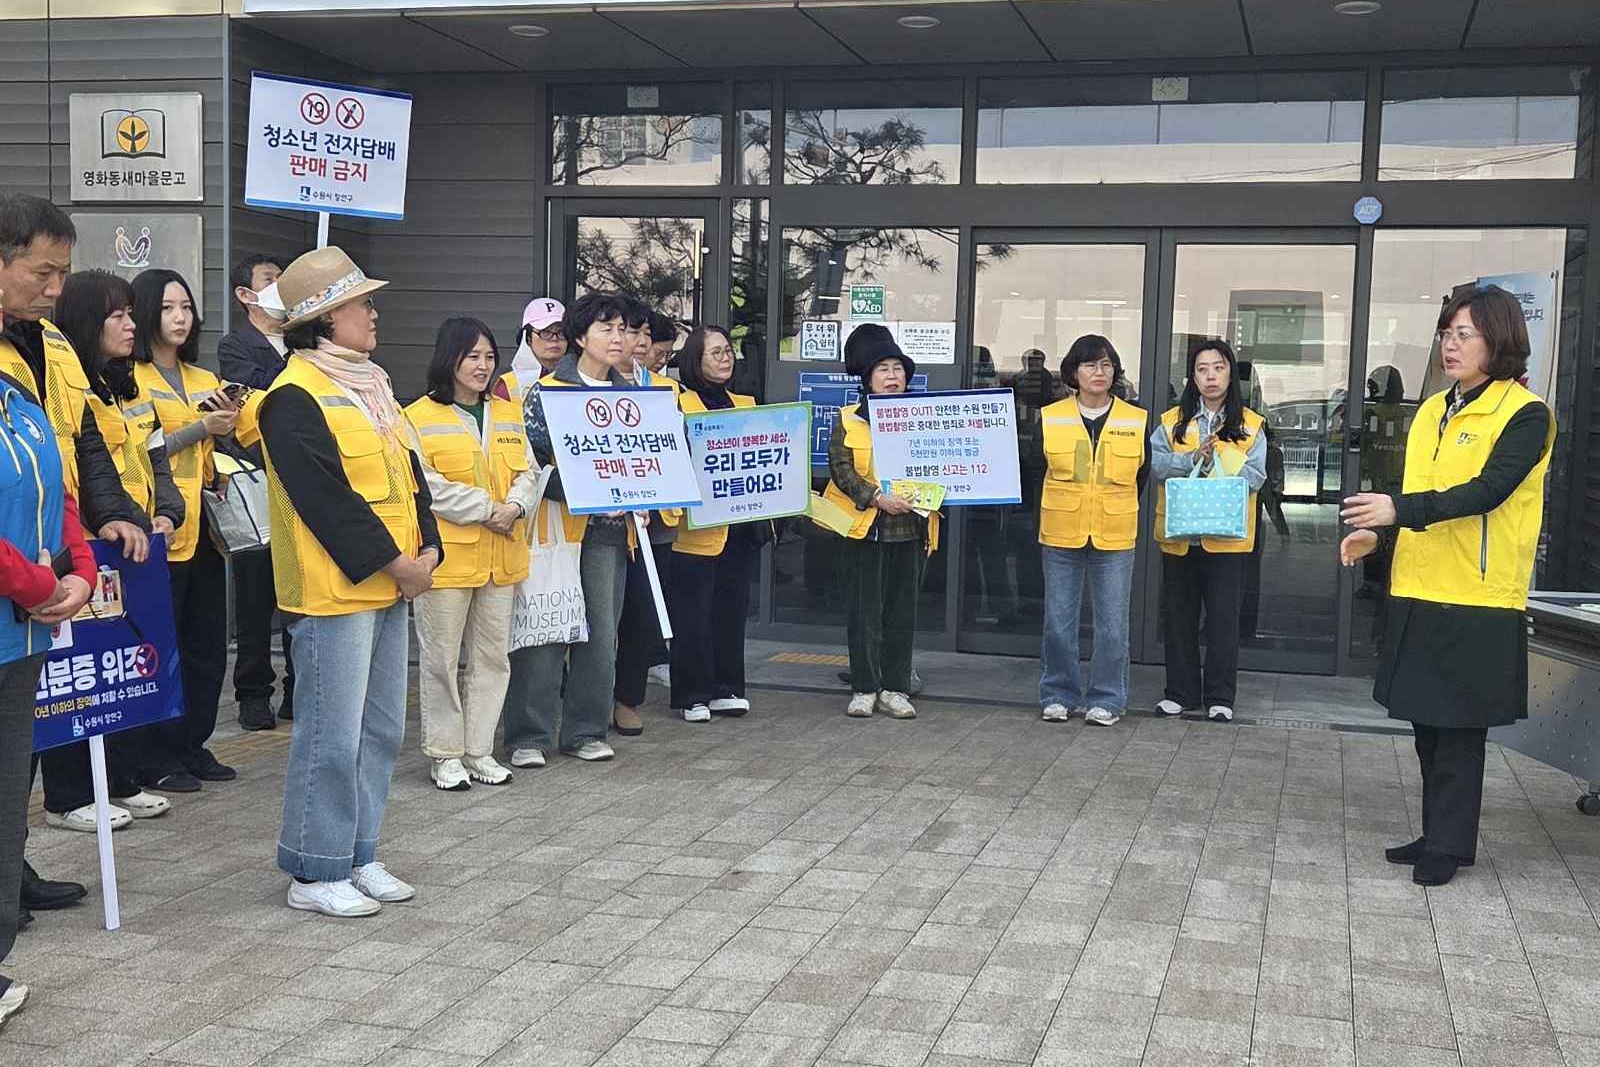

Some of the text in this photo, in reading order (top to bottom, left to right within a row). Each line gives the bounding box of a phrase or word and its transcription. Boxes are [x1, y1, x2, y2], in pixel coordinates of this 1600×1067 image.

[263, 124, 397, 161] 청소년 전자담배
[290, 154, 368, 182] 판매 금지
[83, 170, 186, 187] 영화동새마을문고
[312, 190, 332, 201] 수원시
[544, 302, 555, 313] P
[864, 304, 882, 313] AED
[876, 402, 1008, 419] 불법촬영 OUT! 안전한 수원 만들기
[878, 416, 1009, 433] 불법촬영은 중대한 범죄로 처벌됩니다.
[563, 432, 678, 456] 청소년 전자담배
[706, 437, 740, 451] 청소년이
[741, 433, 769, 447] 행복한
[592, 457, 662, 479] 판매 금지
[703, 446, 790, 474] 우리 모두가
[905, 463, 989, 477] 불법촬영 신고는 112
[622, 490, 640, 499] 수원시
[712, 472, 783, 499] 만들어요!
[730, 504, 746, 513] 수원시
[515, 586, 583, 610] NATIONA
[514, 607, 581, 630] MUSEUM
[512, 630, 566, 648] KOREA
[101, 644, 149, 685] 위조
[50, 701, 76, 715] 이하의
[76, 694, 101, 710] 징역에
[101, 690, 118, 705] 처할
[118, 689, 126, 700] 수
[126, 681, 160, 698] 있습니다.
[84, 715, 103, 729] 수원시
